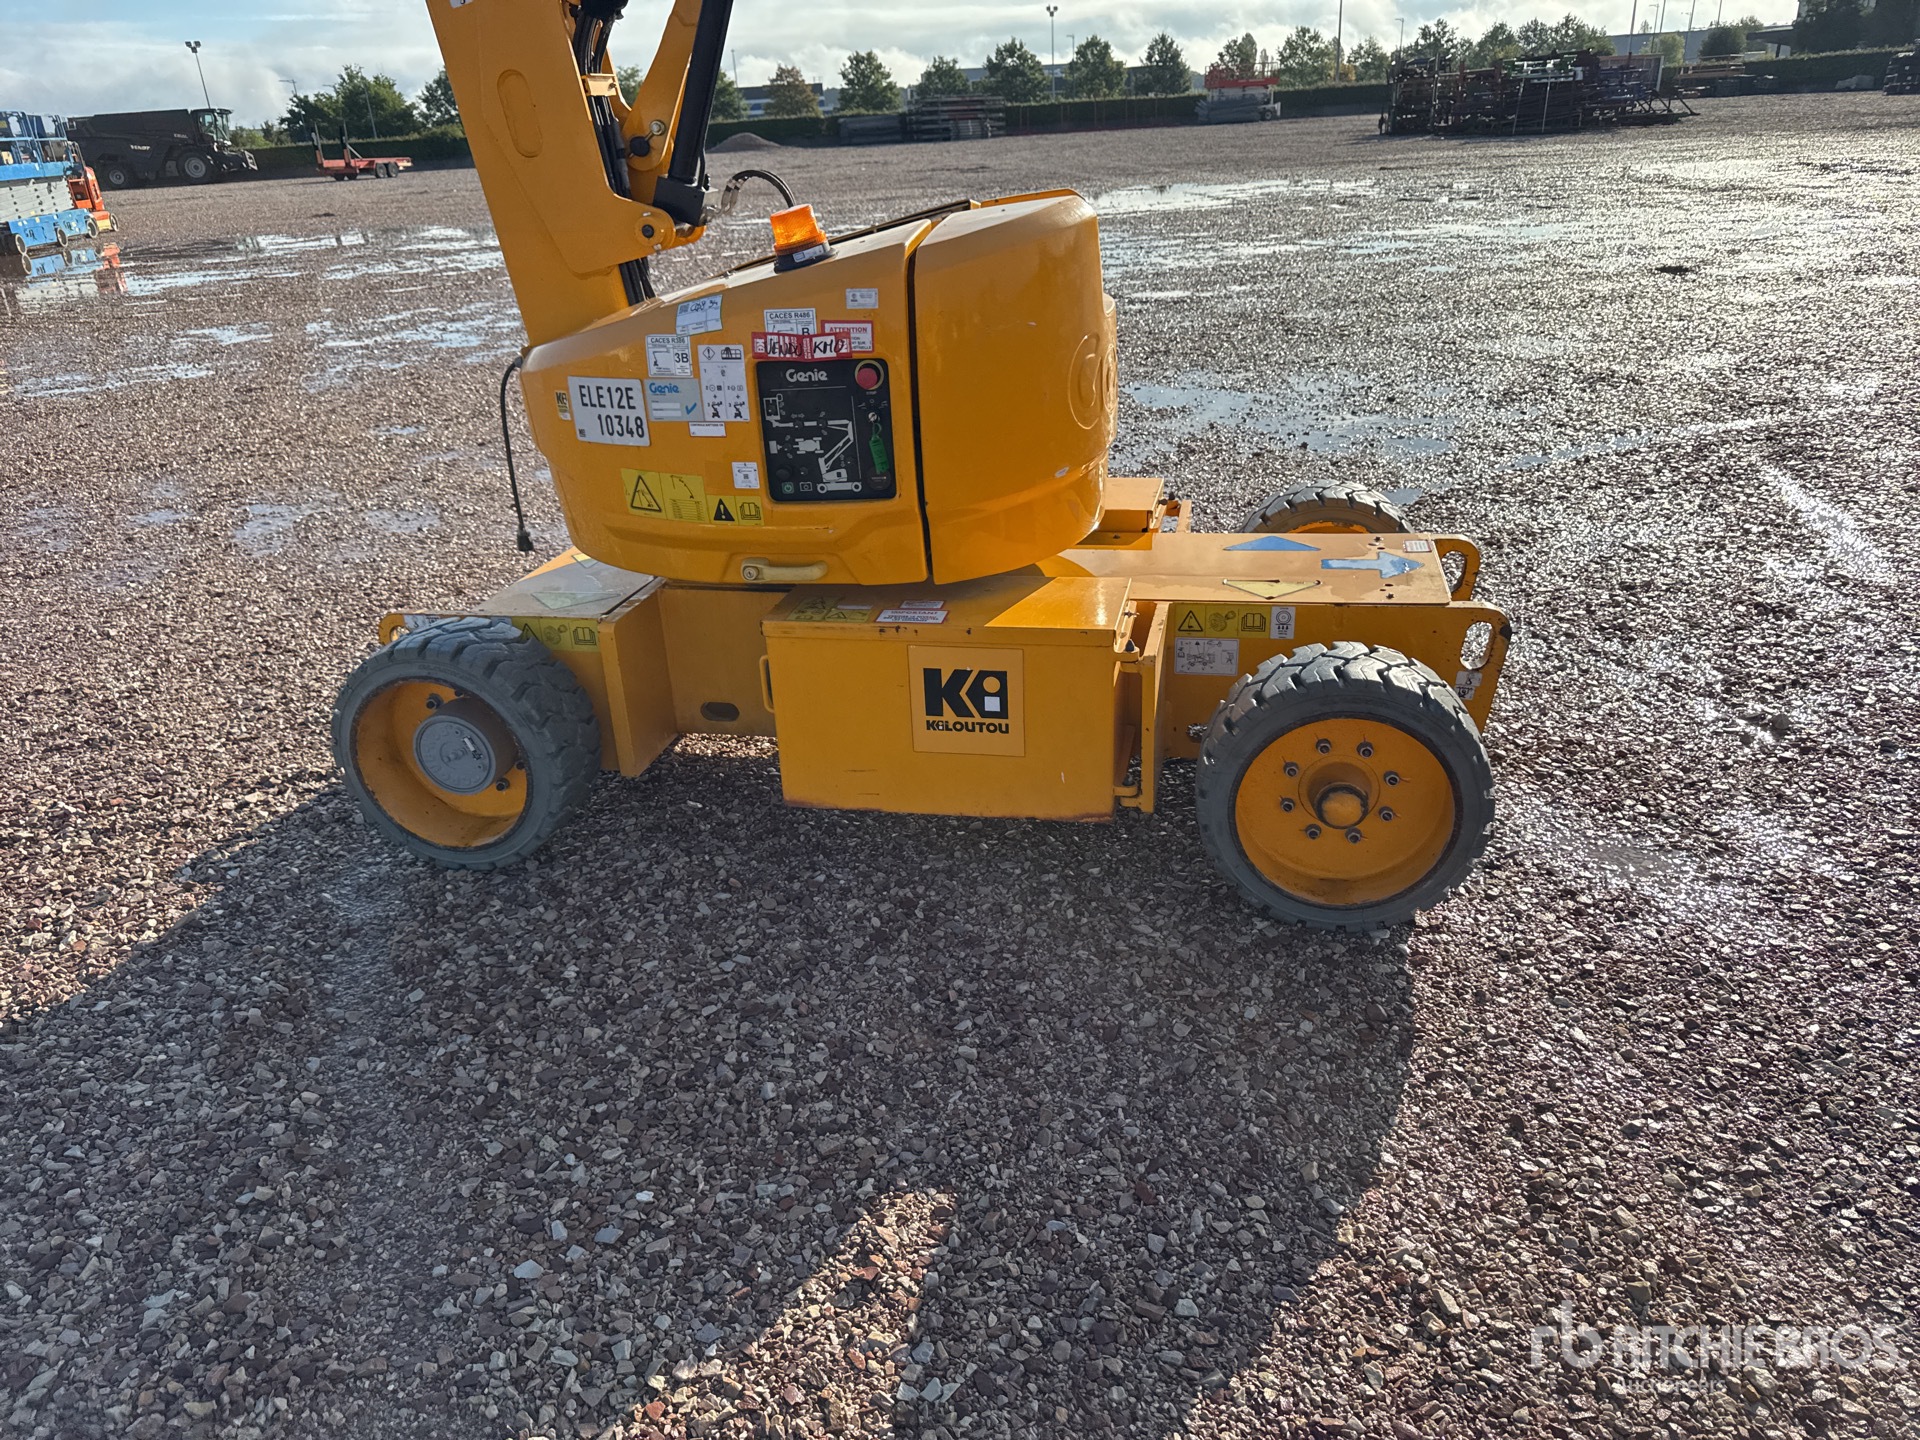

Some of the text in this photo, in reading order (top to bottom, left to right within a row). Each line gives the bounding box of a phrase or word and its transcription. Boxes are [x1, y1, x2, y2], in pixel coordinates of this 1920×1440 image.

[794, 311, 811, 319] R486
[674, 352, 689, 363] 3B
[785, 368, 828, 383] Genie
[649, 382, 680, 394] Genie
[578, 384, 637, 410] ELE12E
[597, 414, 645, 438] 10348
